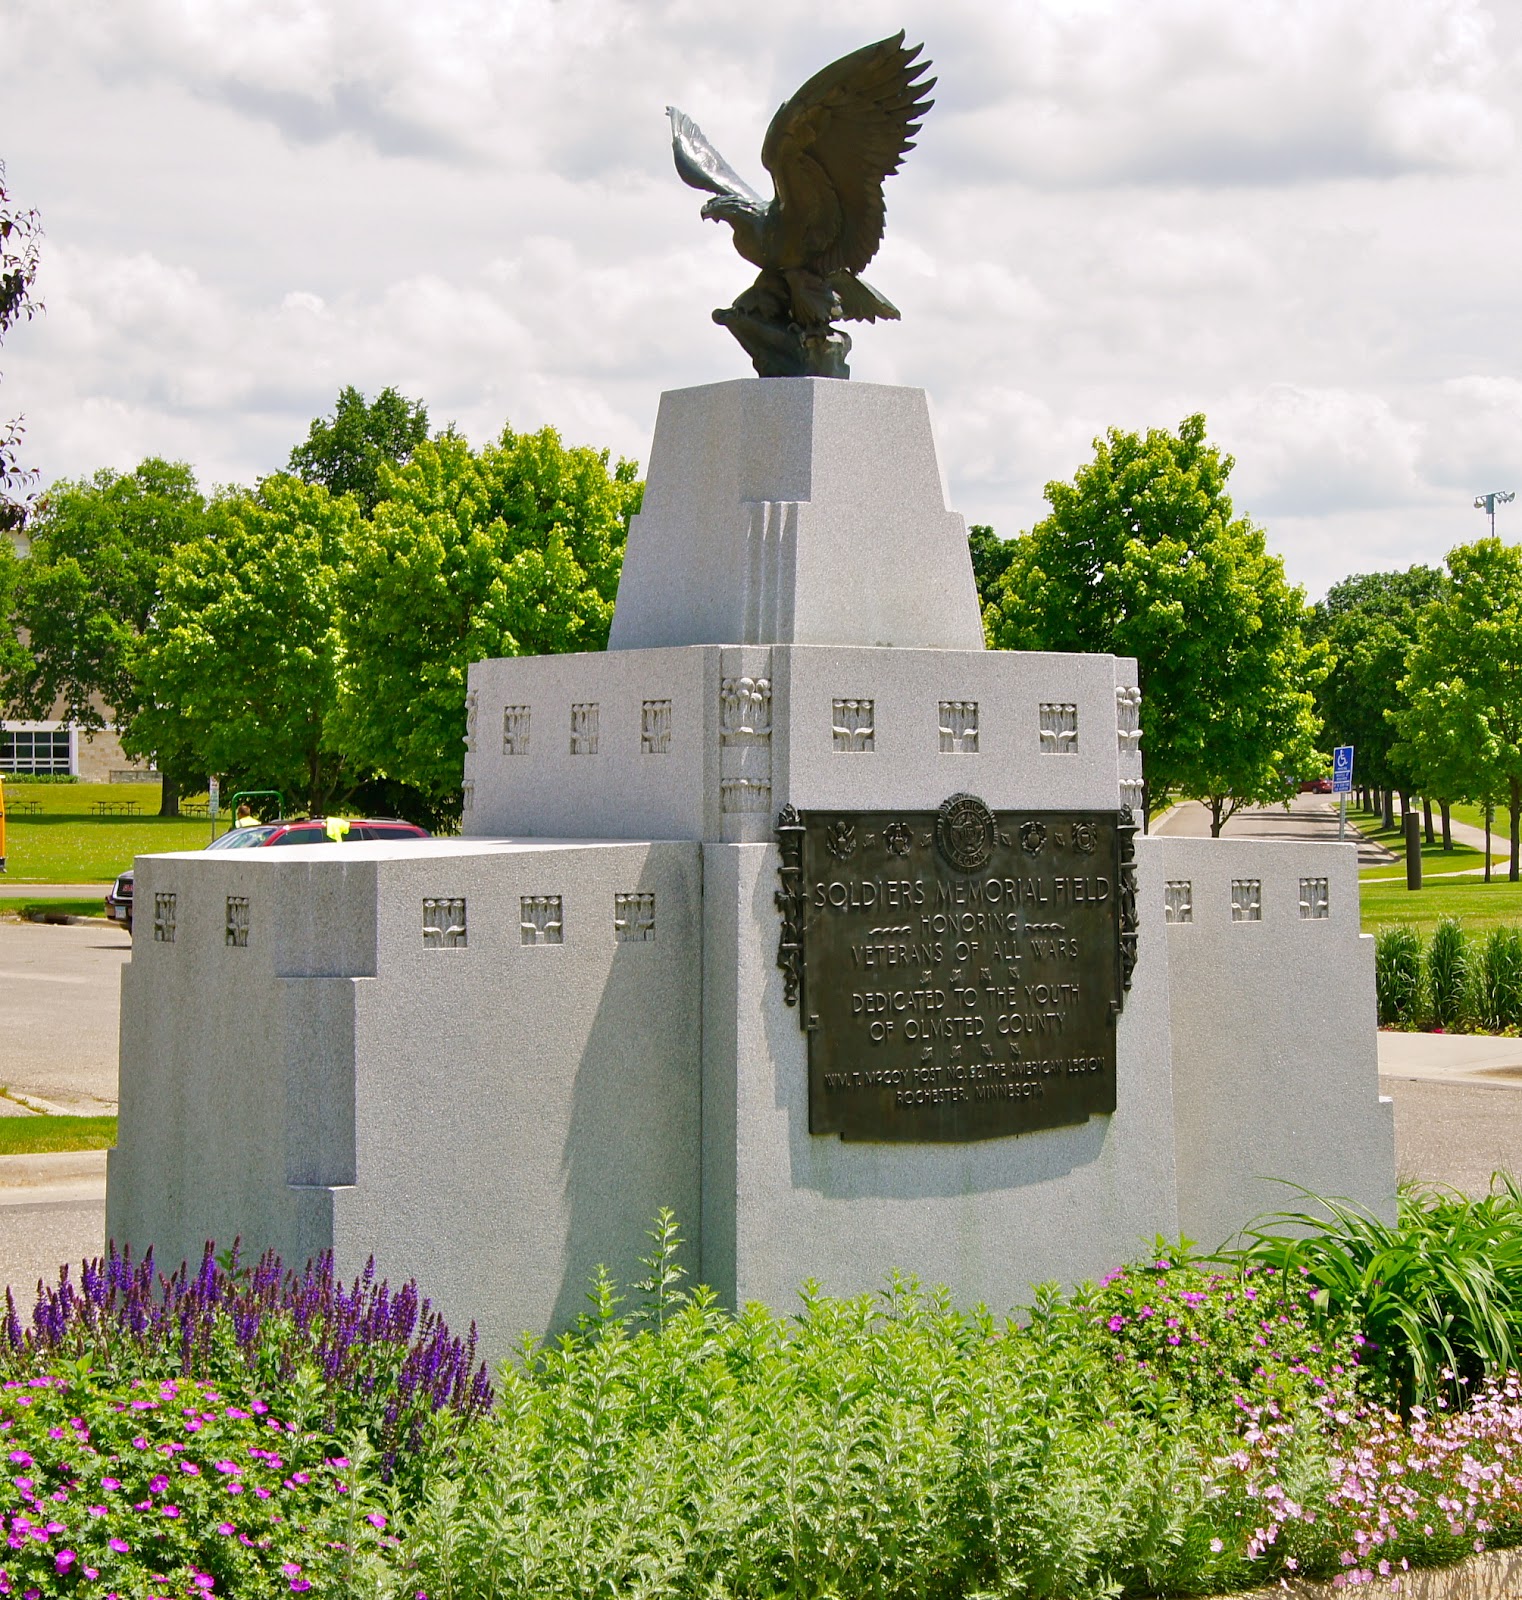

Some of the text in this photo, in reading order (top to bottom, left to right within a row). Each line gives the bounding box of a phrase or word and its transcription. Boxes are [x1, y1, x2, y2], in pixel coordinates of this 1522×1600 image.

[814, 877, 1110, 907] SOLDIERS MEMORIAL FIELD
[920, 912, 1018, 934] HONORING
[851, 938, 1079, 965] VETERANS OF ALL WARS
[852, 983, 1080, 1012] DEDICATED TO THE YOUTH
[870, 1012, 1066, 1041] OF OLMSTED COUNTY
[913, 1067, 942, 1082] POST
[946, 1065, 967, 1080] NO.
[986, 1062, 1006, 1077] THE
[1011, 1059, 1063, 1076] AMERICAN
[1067, 1057, 1105, 1073] LEGION
[975, 1081, 1044, 1100] MINNESOTA
